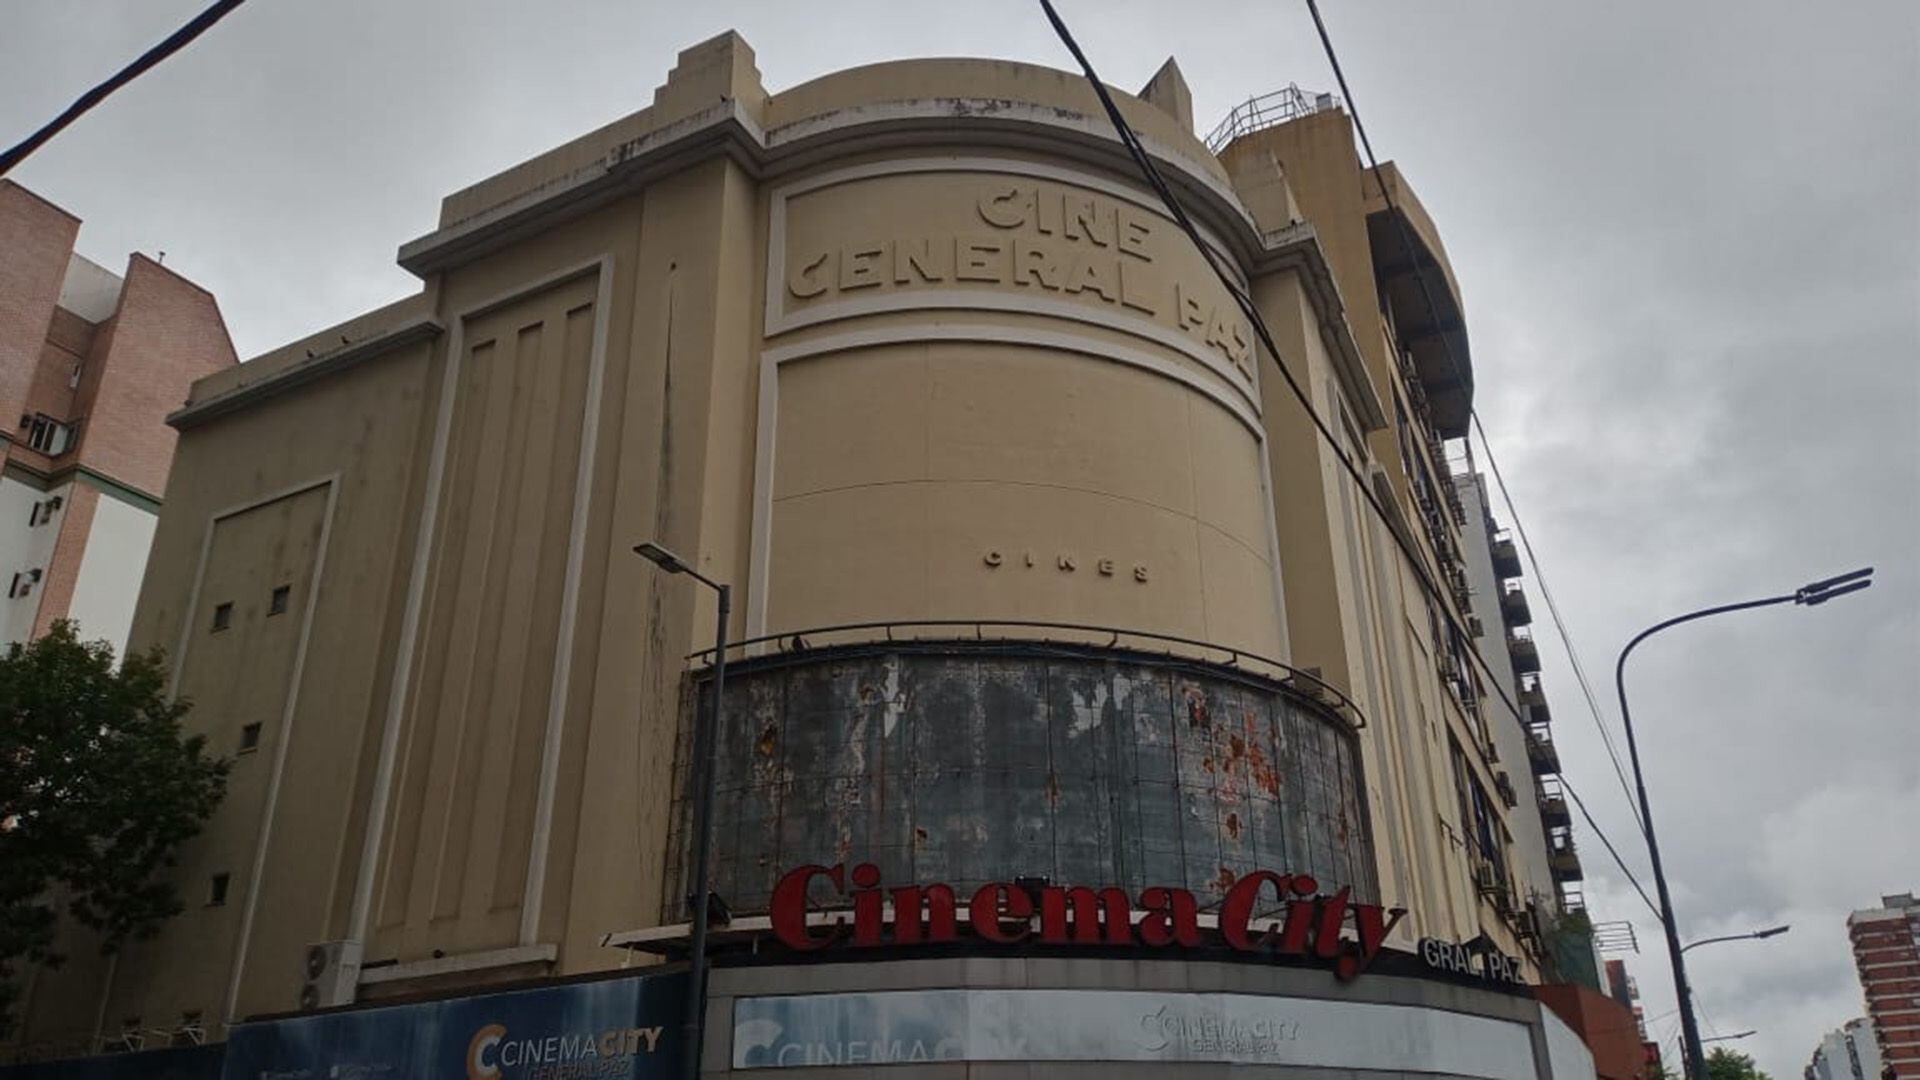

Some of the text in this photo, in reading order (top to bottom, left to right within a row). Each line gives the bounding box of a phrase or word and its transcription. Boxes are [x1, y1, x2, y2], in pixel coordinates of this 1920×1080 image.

[978, 184, 1152, 262] CINE
[789, 236, 1253, 383] GENERAL PAZ
[984, 550, 1149, 584] CINES
[1488, 950, 1526, 984] PAZ
[501, 1026, 664, 1067] CINEMACITY
